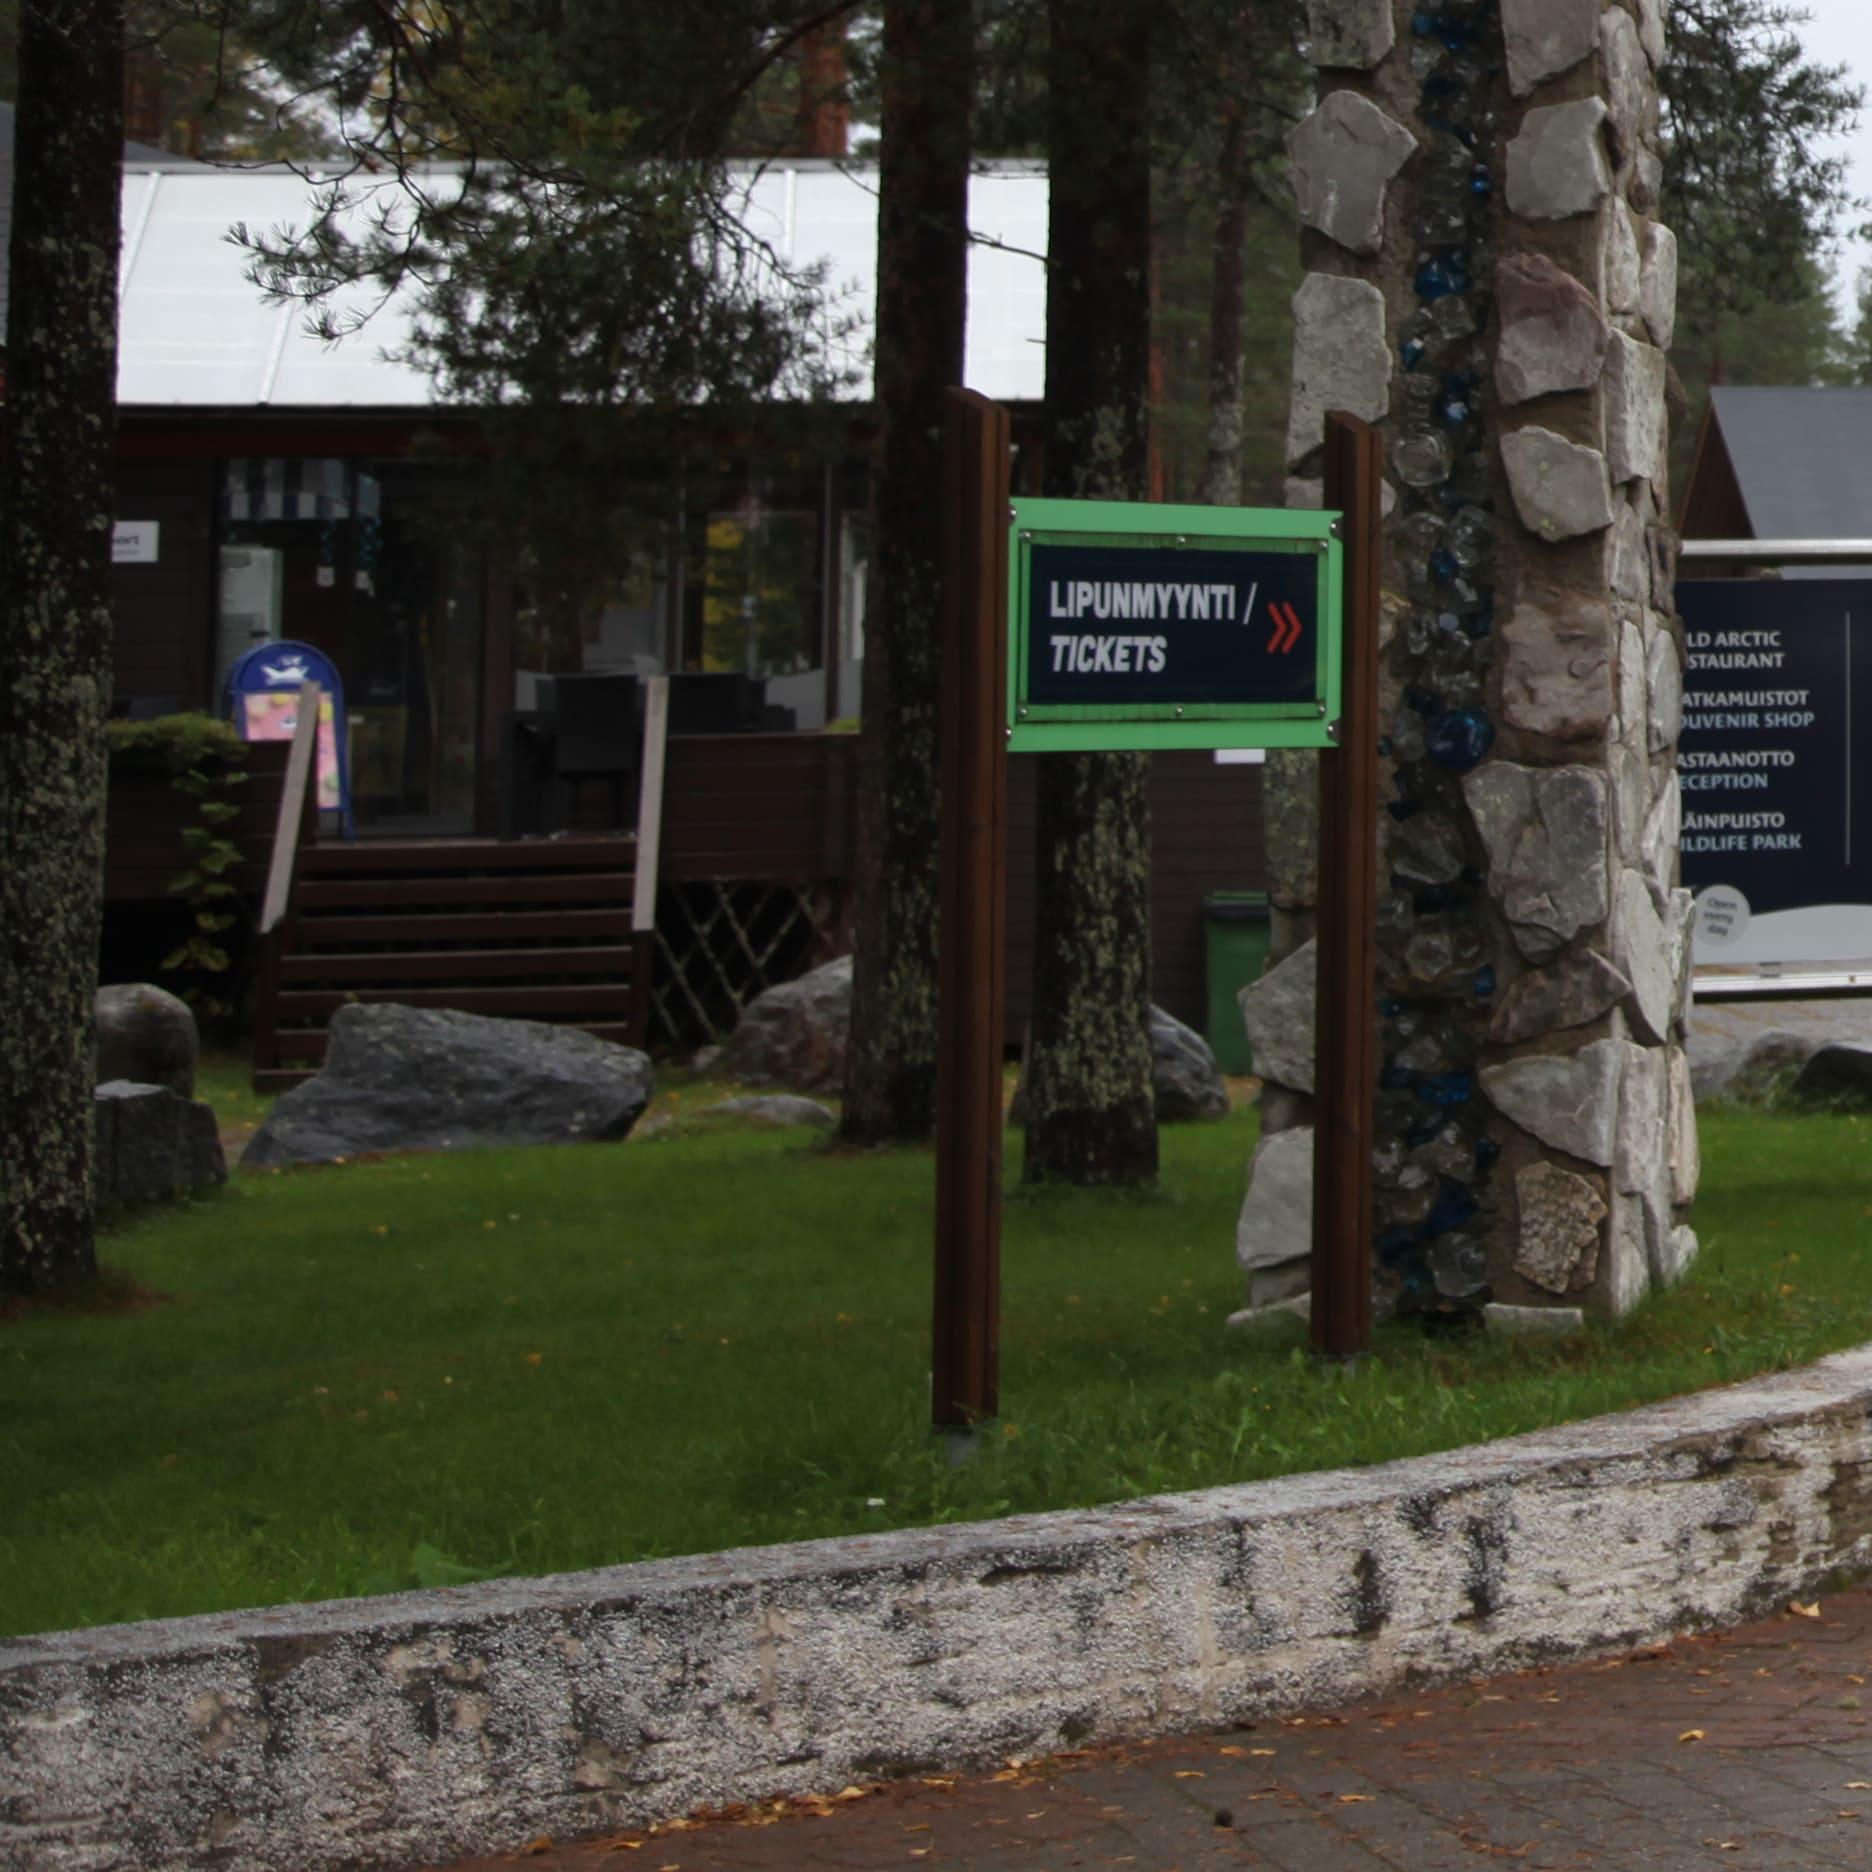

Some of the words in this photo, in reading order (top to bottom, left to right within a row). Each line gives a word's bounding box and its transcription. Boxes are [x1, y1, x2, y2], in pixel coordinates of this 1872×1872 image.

[1050, 581, 1235, 620] LIPUNMYYNTI
[1687, 631, 1711, 647] LD
[1715, 630, 1781, 647] ARCTIC
[1051, 635, 1167, 672] TICKETS
[1688, 653, 1785, 669] STAURANT
[1682, 690, 1809, 707] ATKAMUISTOT
[1681, 712, 1760, 729] OUVENIR
[1765, 711, 1815, 728] SHOP
[1677, 750, 1795, 768] ASTAANOTTO
[1680, 773, 1768, 790] ECEPTION
[1680, 811, 1785, 830] ÄINPUISTO
[1680, 835, 1748, 852] ILDLIFE
[1752, 834, 1803, 850] PARK
